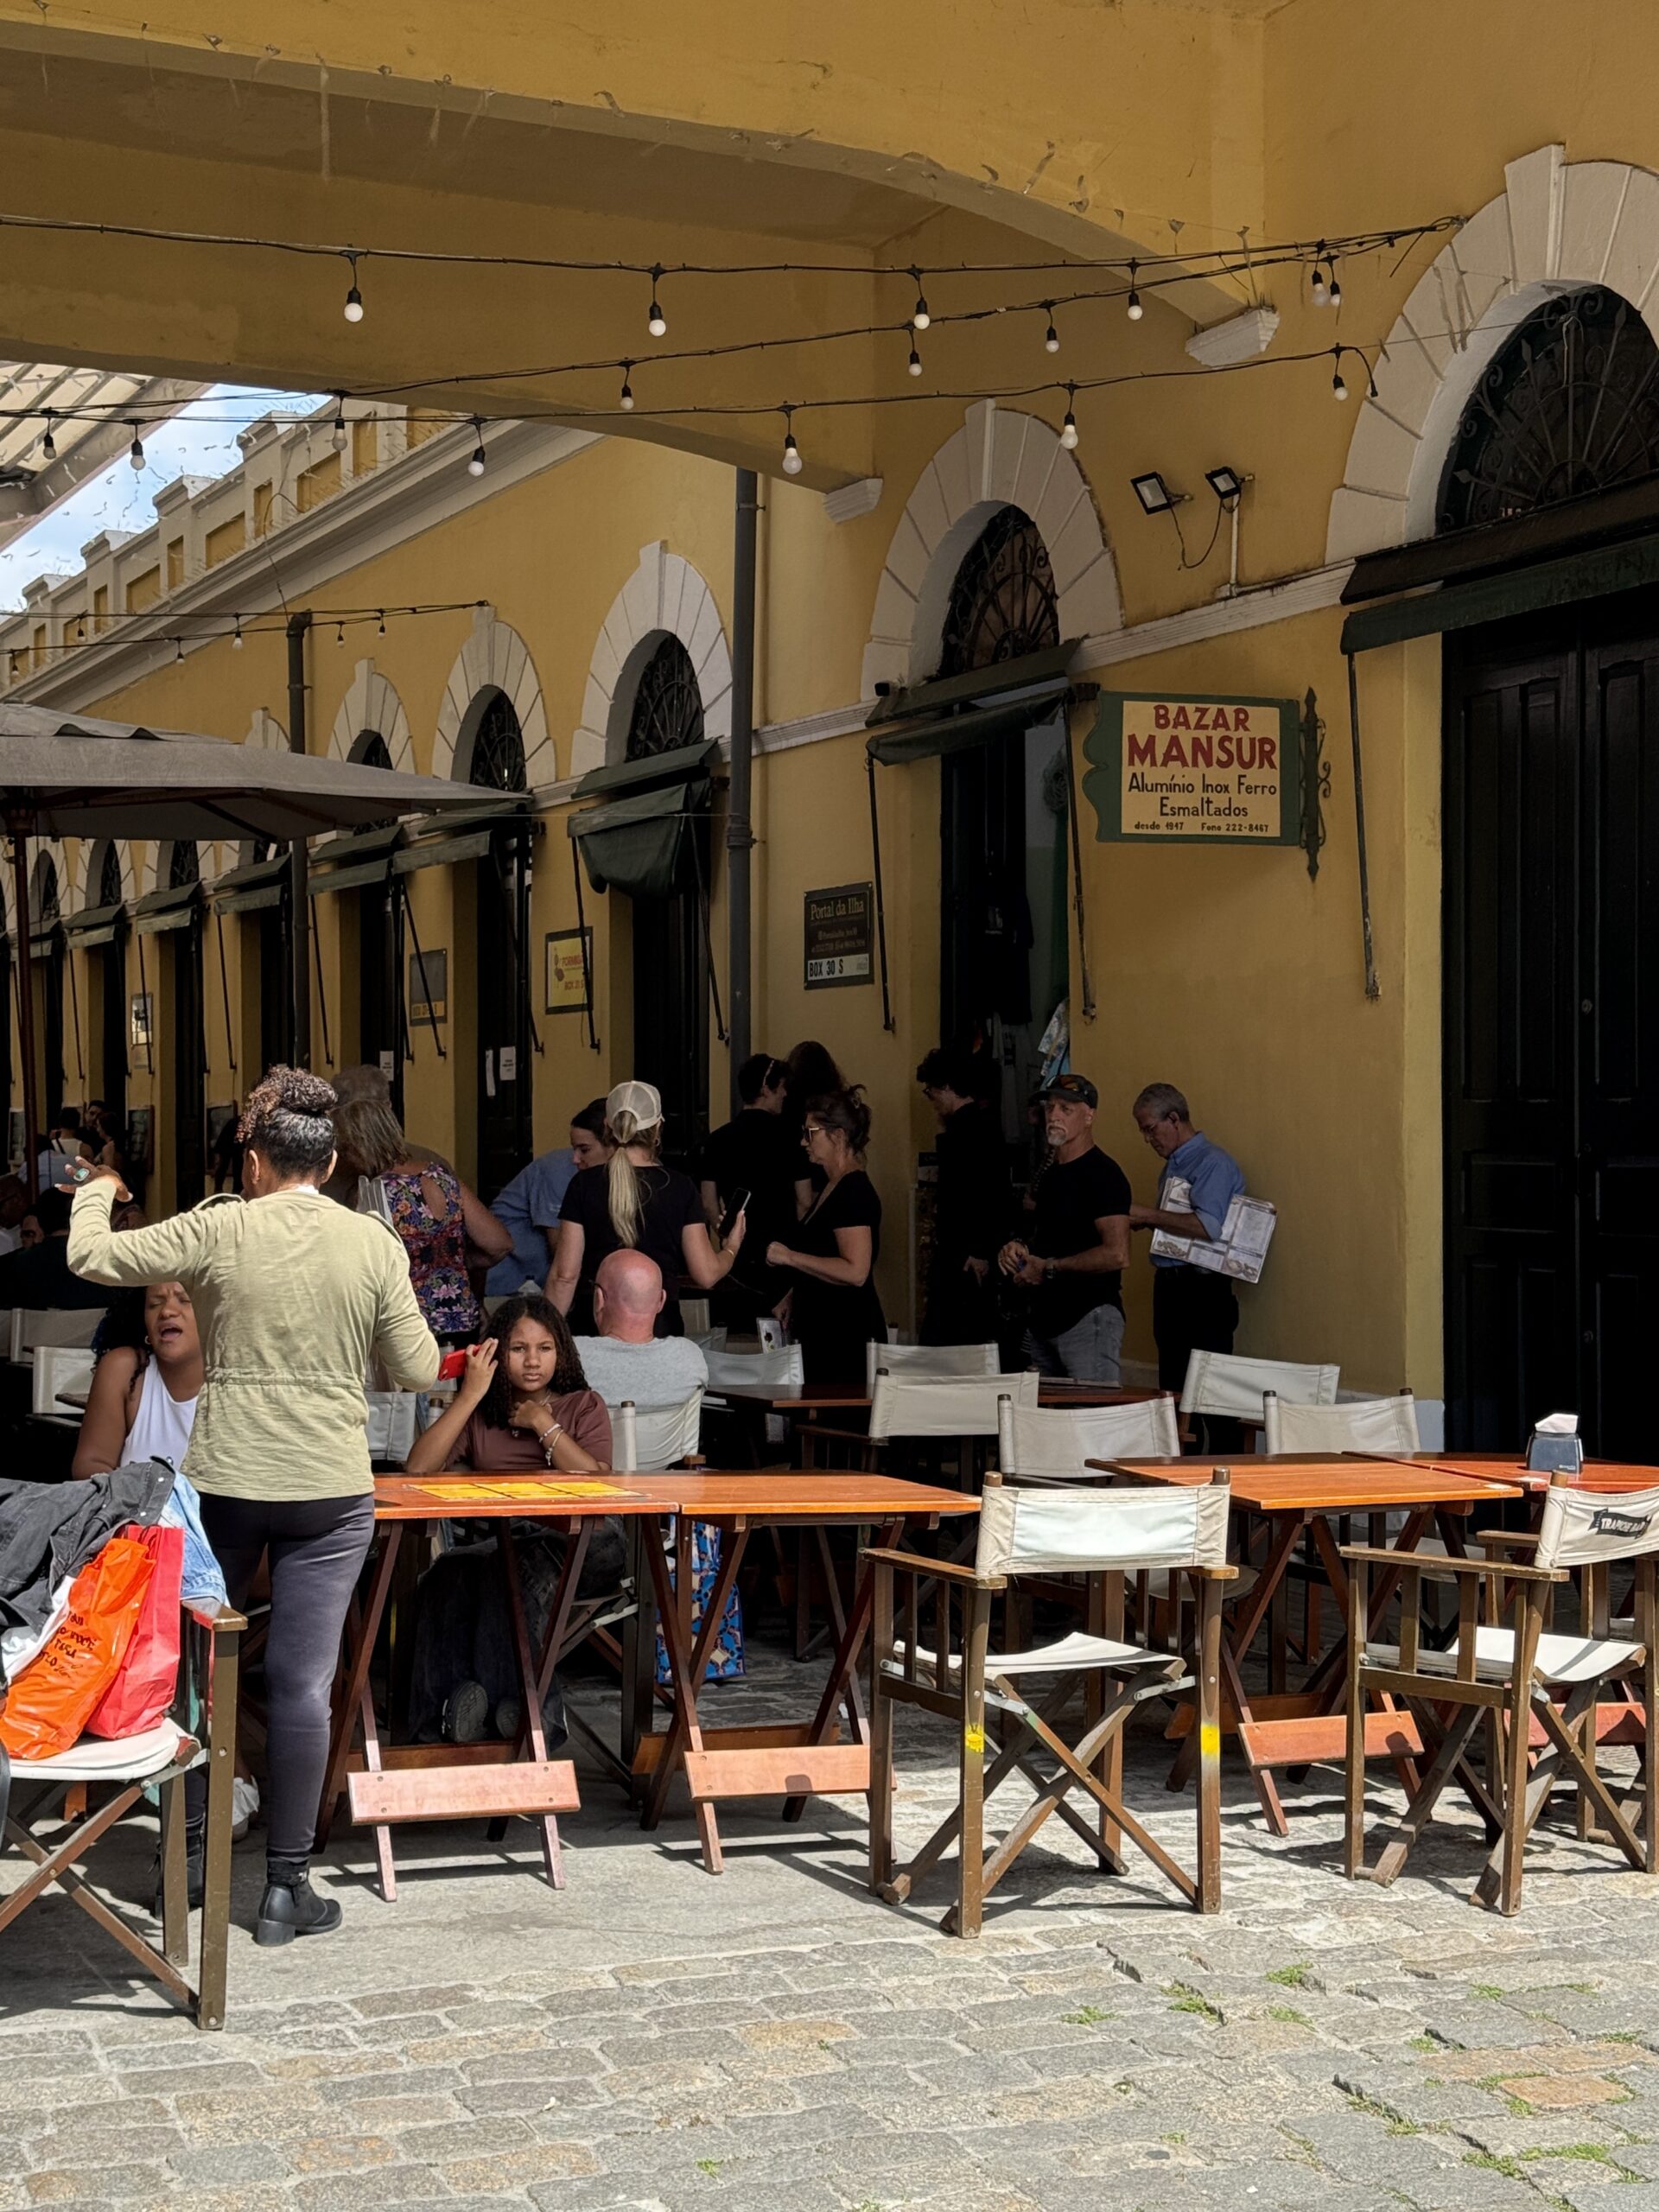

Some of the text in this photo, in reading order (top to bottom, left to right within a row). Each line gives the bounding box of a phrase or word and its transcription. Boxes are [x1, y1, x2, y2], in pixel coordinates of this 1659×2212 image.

[1154, 704, 1251, 732] BAZAR
[1128, 734, 1278, 770] MANSUR
[1128, 772, 1277, 795] Alumínio Inox Ferro
[1160, 797, 1249, 817] Esmaltados
[1134, 821, 1160, 830] desde
[810, 897, 864, 920] Portal da Ilha
[809, 961, 823, 977] BOX
[826, 959, 836, 976] 30
[838, 958, 843, 975] S
